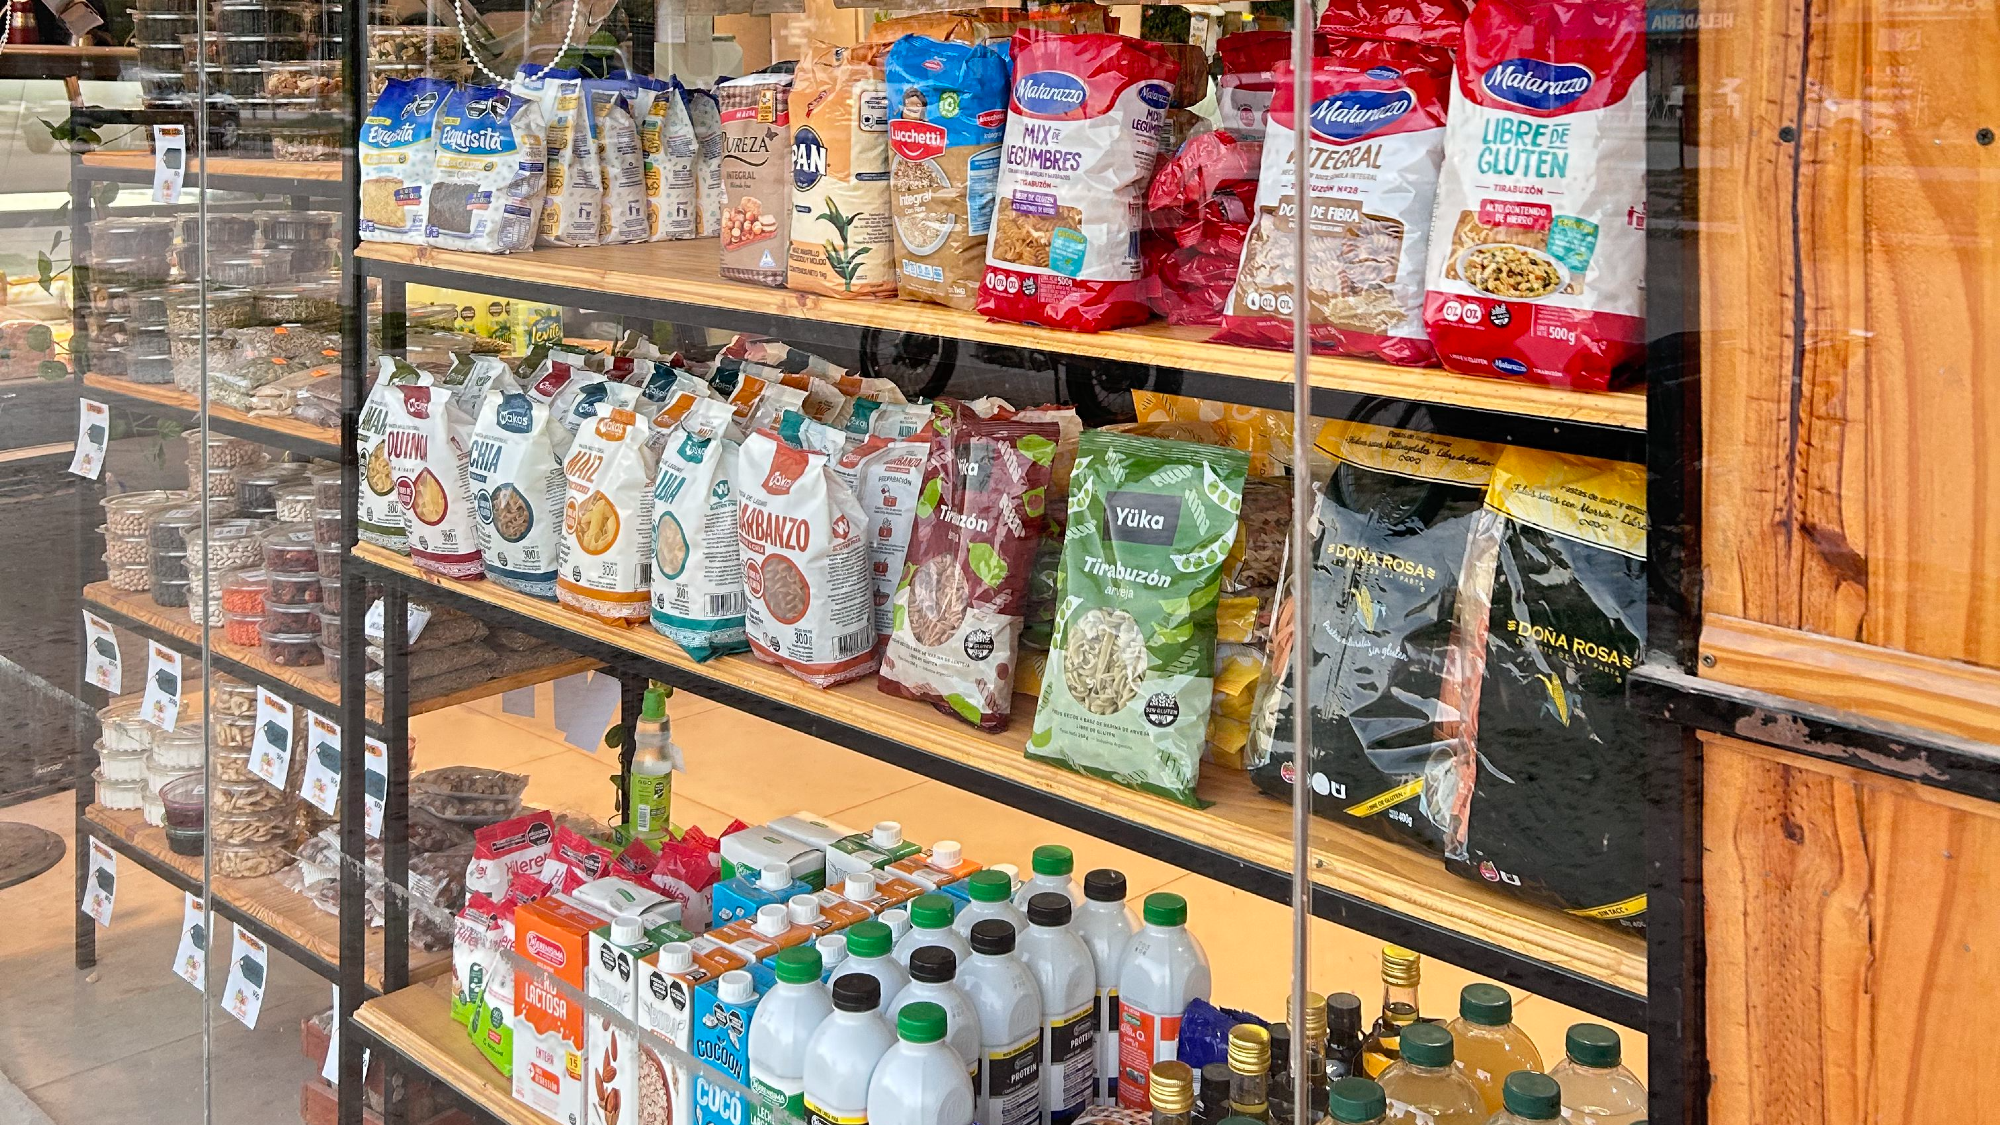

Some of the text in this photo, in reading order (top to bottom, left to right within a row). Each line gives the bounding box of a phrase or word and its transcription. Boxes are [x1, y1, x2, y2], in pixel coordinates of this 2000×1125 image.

[1487, 65, 1588, 95] Matarazzo
[1017, 79, 1084, 104] Matarazzo
[1310, 99, 1408, 125] Matarazzo
[369, 122, 415, 147] Exquisita
[442, 127, 502, 152] Exquisita
[721, 131, 770, 153] PUREZA
[891, 126, 941, 145] Lucchetti
[1023, 124, 1051, 145] MIX
[1482, 118, 1549, 147] LIBRE
[1007, 144, 1082, 172] LEGUMBRES
[1478, 147, 1569, 178] GLUTEN
[726, 171, 756, 180] INTEGRAL
[900, 189, 932, 206] Integral
[1493, 183, 1544, 196] TIRABUZÓN
[1310, 205, 1326, 218] DE
[1327, 206, 1360, 222] FIBRA
[1486, 203, 1547, 216] ALTO CONTENIDO
[1506, 214, 1533, 225] HIERRO
[1465, 308, 1479, 320] 0%
[500, 411, 529, 427] Wakas
[470, 440, 502, 473] CHIA
[1561, 500, 1576, 509] con
[1588, 493, 1598, 501] de
[1115, 506, 1165, 530] Yüka
[1336, 545, 1425, 578] DOÑA ROSA
[1083, 556, 1172, 588] Tirabuzón
[1400, 575, 1424, 586] PASTA
[1105, 584, 1134, 599] arveja
[1381, 642, 1409, 661] gluten
[1518, 621, 1621, 667] DOÑA ROSA
[1146, 706, 1178, 715] SIN GLUTEN
[1385, 791, 1404, 804] GLUTEN
[1609, 906, 1625, 916] TACC
[525, 982, 567, 1020] LACTOSA
[569, 1057, 578, 1069] 15
[697, 1039, 743, 1081] COCOON
[1011, 1063, 1037, 1084] PROTEIN
